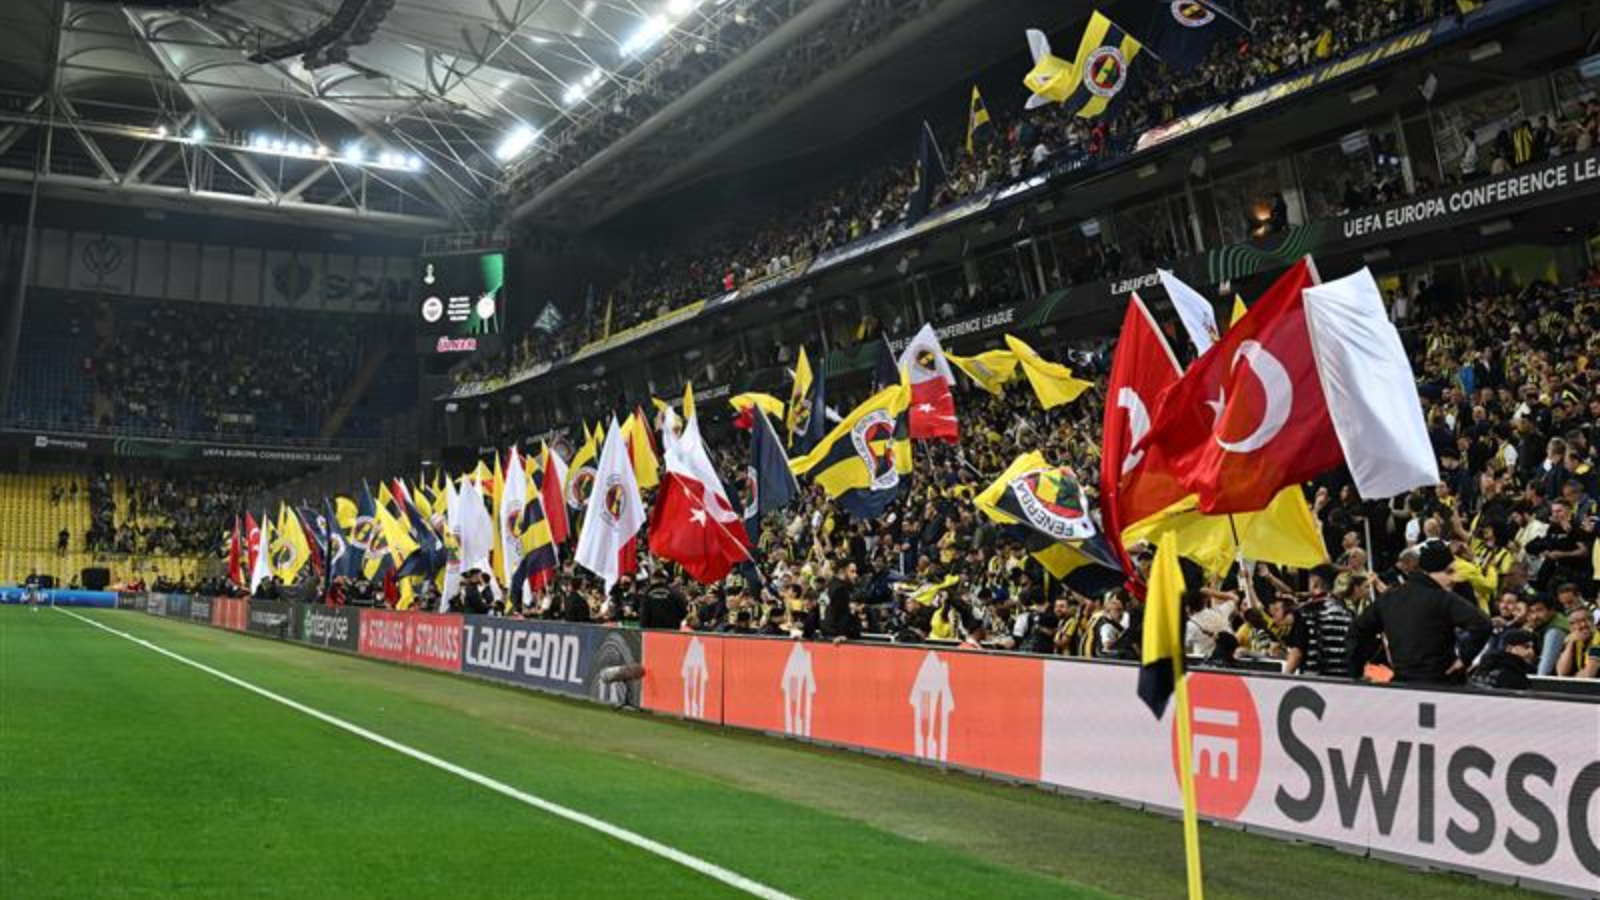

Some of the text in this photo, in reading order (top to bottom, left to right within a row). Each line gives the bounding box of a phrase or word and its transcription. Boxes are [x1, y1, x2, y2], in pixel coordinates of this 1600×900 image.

[1343, 157, 1600, 238] UEFA EUROPA CONFERENCE LE
[935, 317, 981, 341] ONFERENCE
[982, 308, 1015, 329] LEAGUE
[259, 451, 311, 461] CONFERENCE
[1015, 482, 1075, 538] FENERBA
[304, 607, 349, 648] enterprise
[369, 618, 404, 652] STRAUSS
[416, 622, 460, 661] STRAUSS
